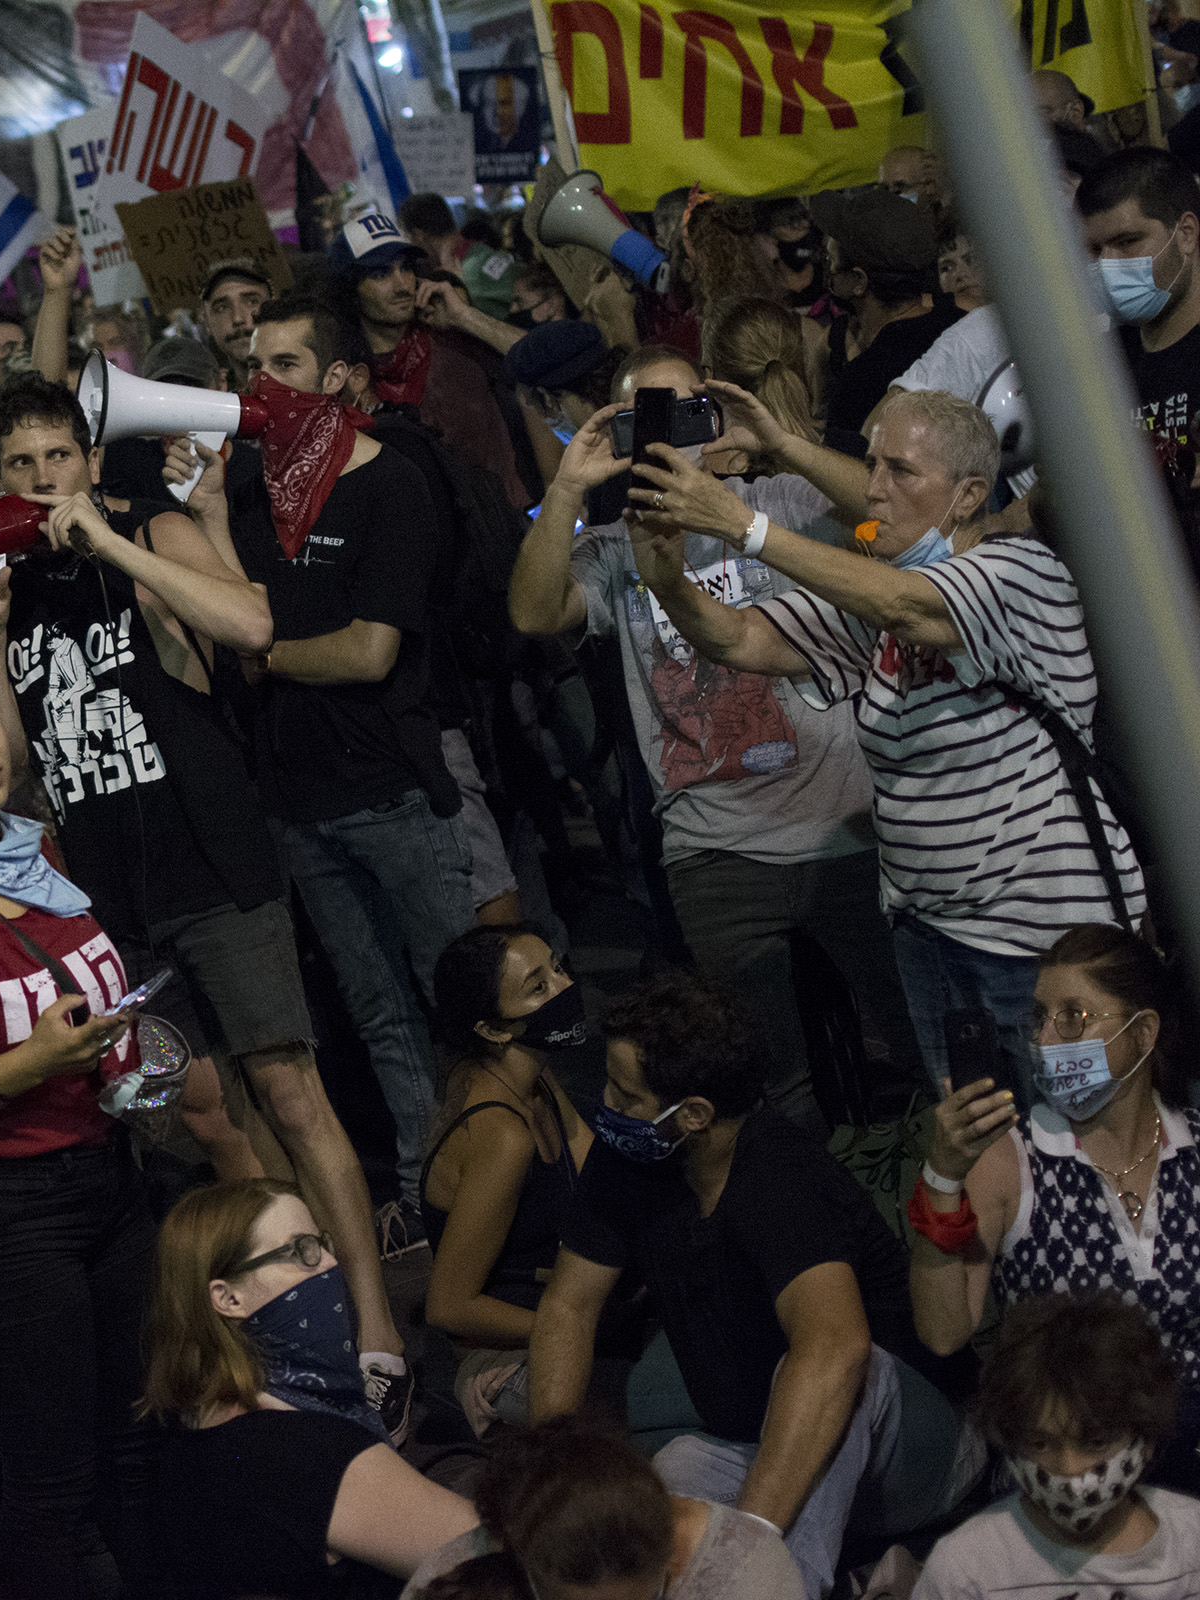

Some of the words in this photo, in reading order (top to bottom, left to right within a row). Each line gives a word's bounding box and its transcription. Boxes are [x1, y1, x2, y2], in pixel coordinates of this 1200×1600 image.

[552, 0, 858, 145] אחים
[323, 536, 345, 547] BEEP
[7, 623, 45, 681] Oi!
[85, 608, 132, 664] Oi!
